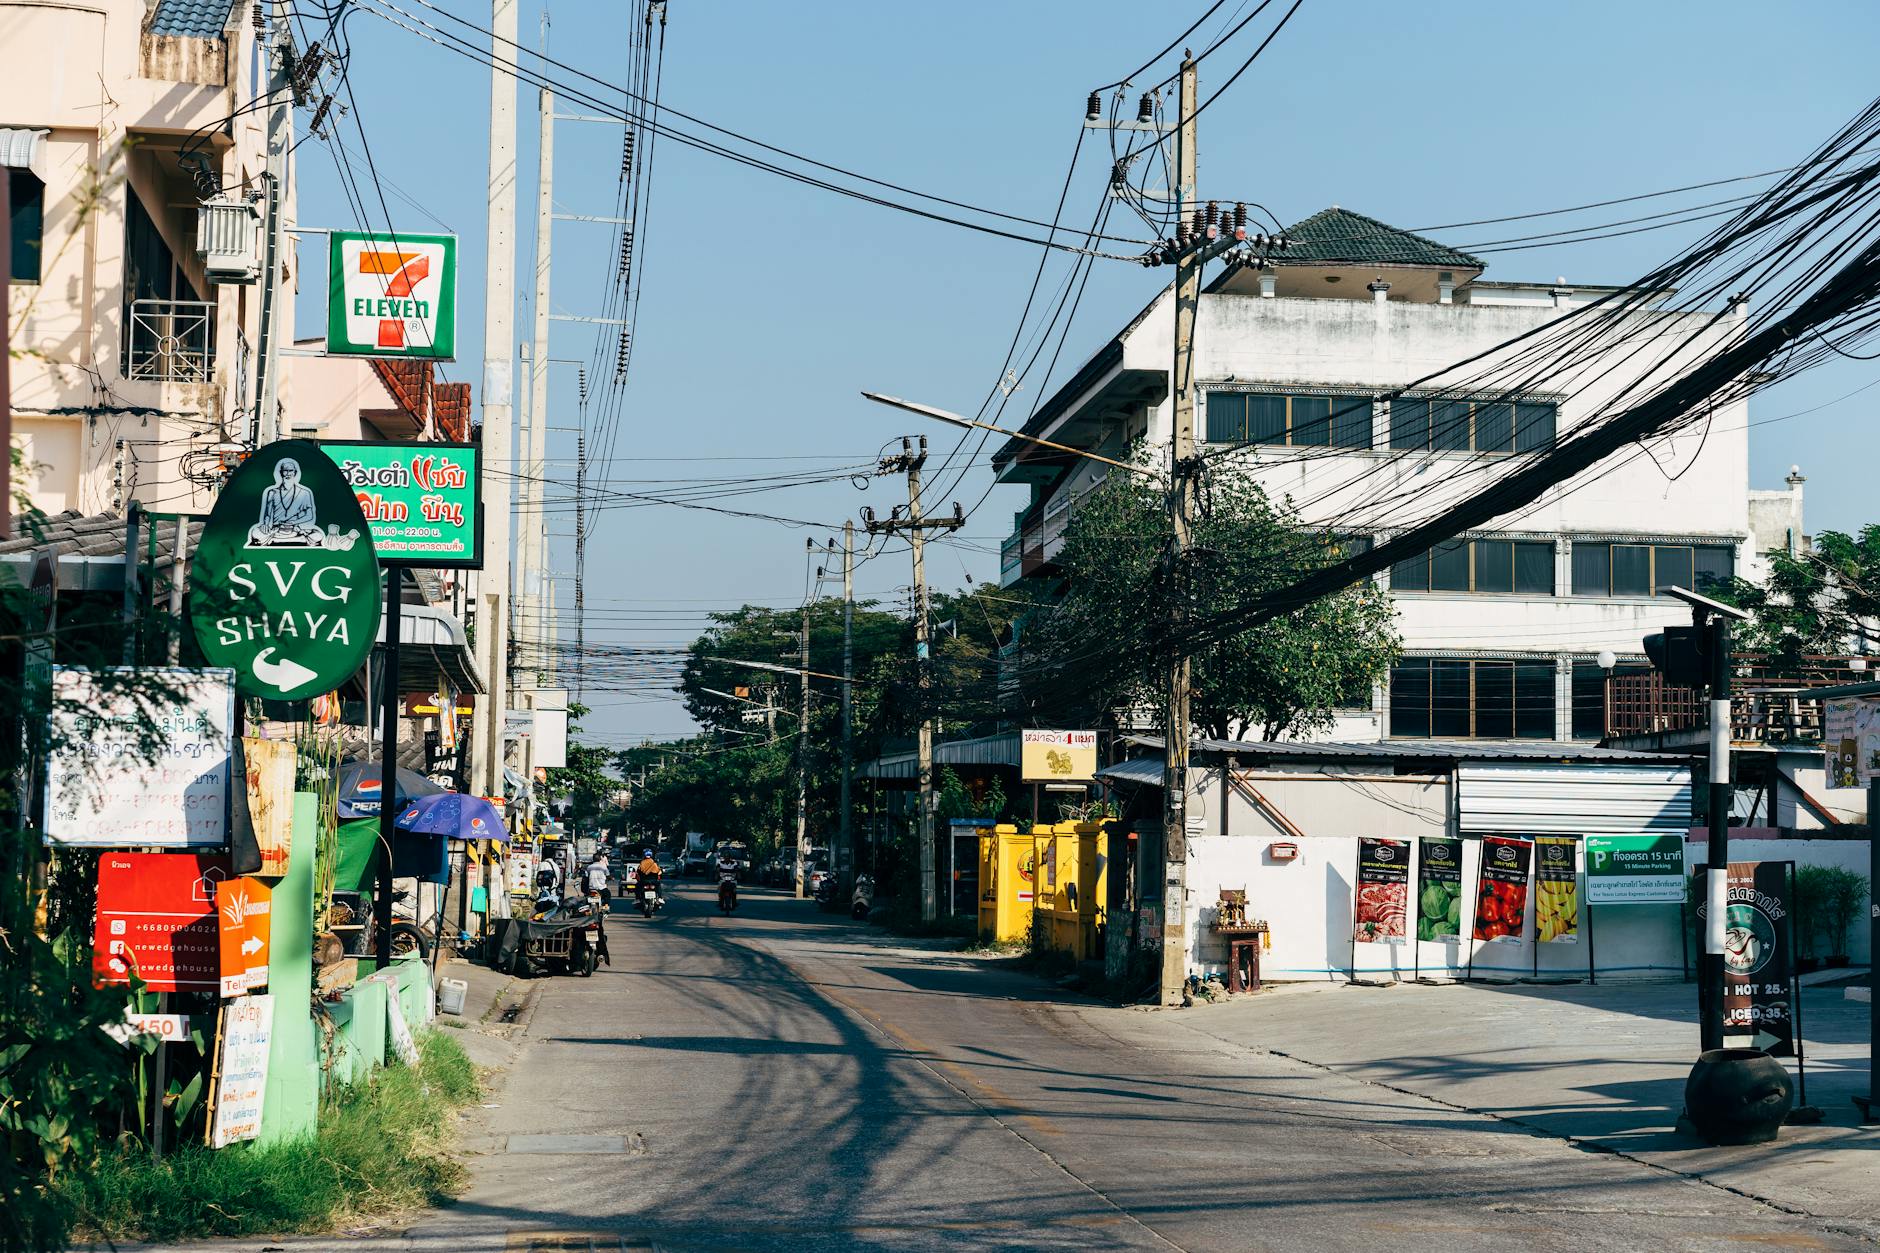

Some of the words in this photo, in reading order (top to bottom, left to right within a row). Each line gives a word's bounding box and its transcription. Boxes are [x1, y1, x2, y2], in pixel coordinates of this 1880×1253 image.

[405, 528, 429, 536] 22.00
[228, 562, 352, 604] SVG
[216, 611, 350, 646] SHAYA
[1595, 851, 1606, 868] P
[1613, 849, 1648, 861] ที่จอดรถ
[1651, 852, 1661, 861] 15
[1663, 850, 1681, 861] นาที
[135, 943, 216, 953] newedgehouse
[1735, 984, 1759, 996] HOT
[1731, 1008, 1760, 1020] ICED
